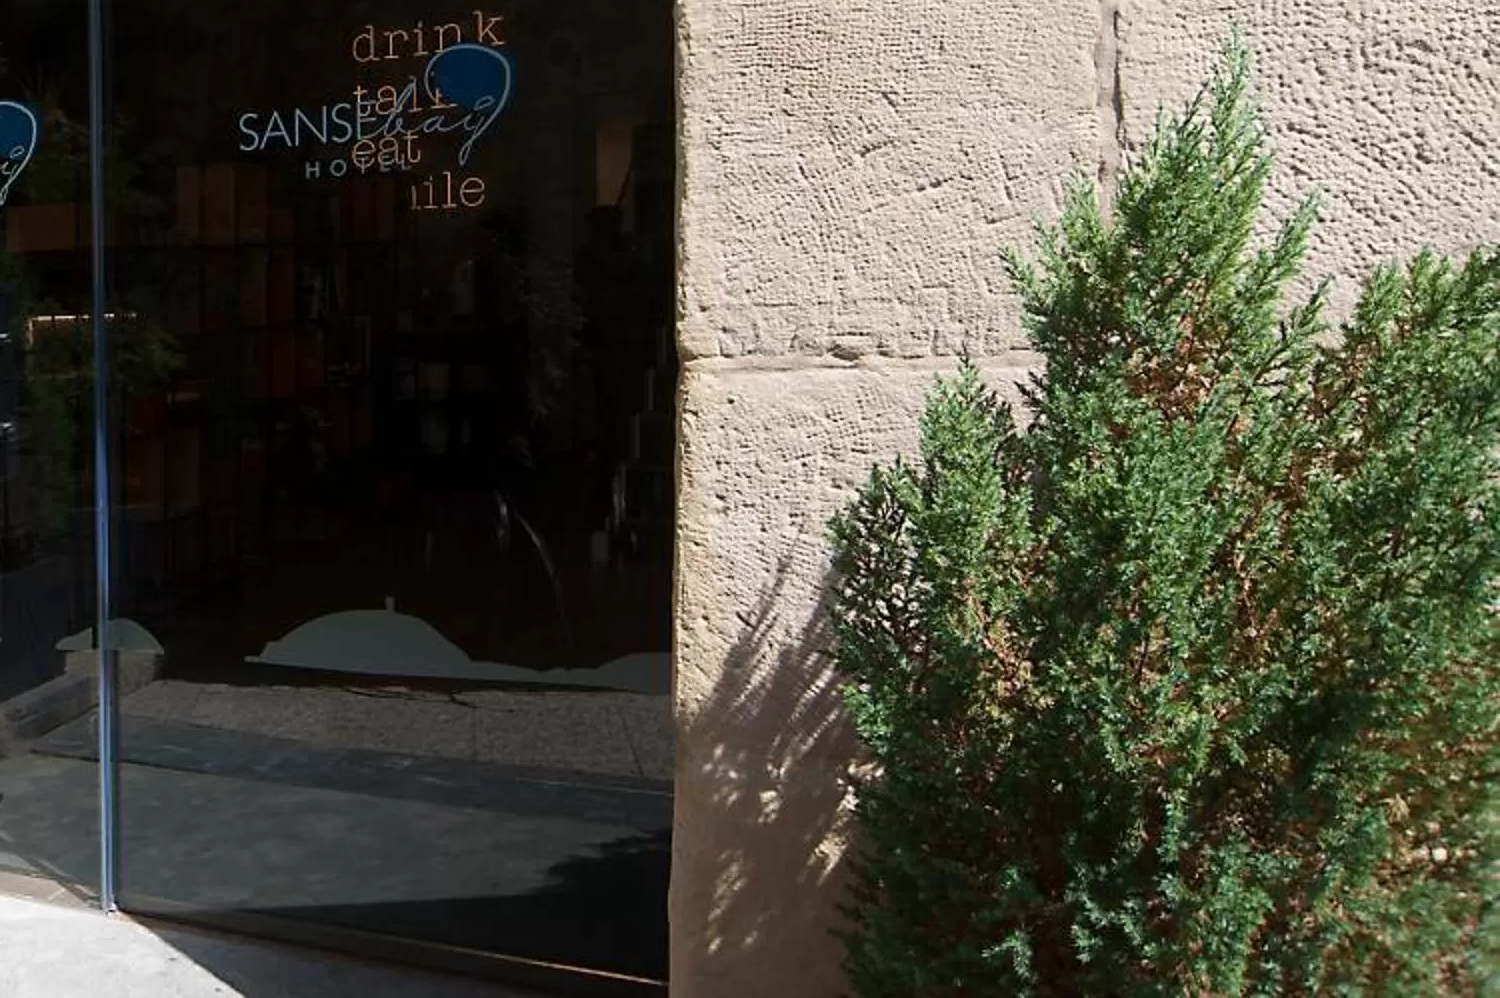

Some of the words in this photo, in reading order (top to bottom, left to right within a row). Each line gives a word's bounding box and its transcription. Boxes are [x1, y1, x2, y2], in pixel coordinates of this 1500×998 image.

[351, 9, 506, 63] drink
[304, 152, 412, 180] HOTEL
[351, 128, 422, 169] eat
